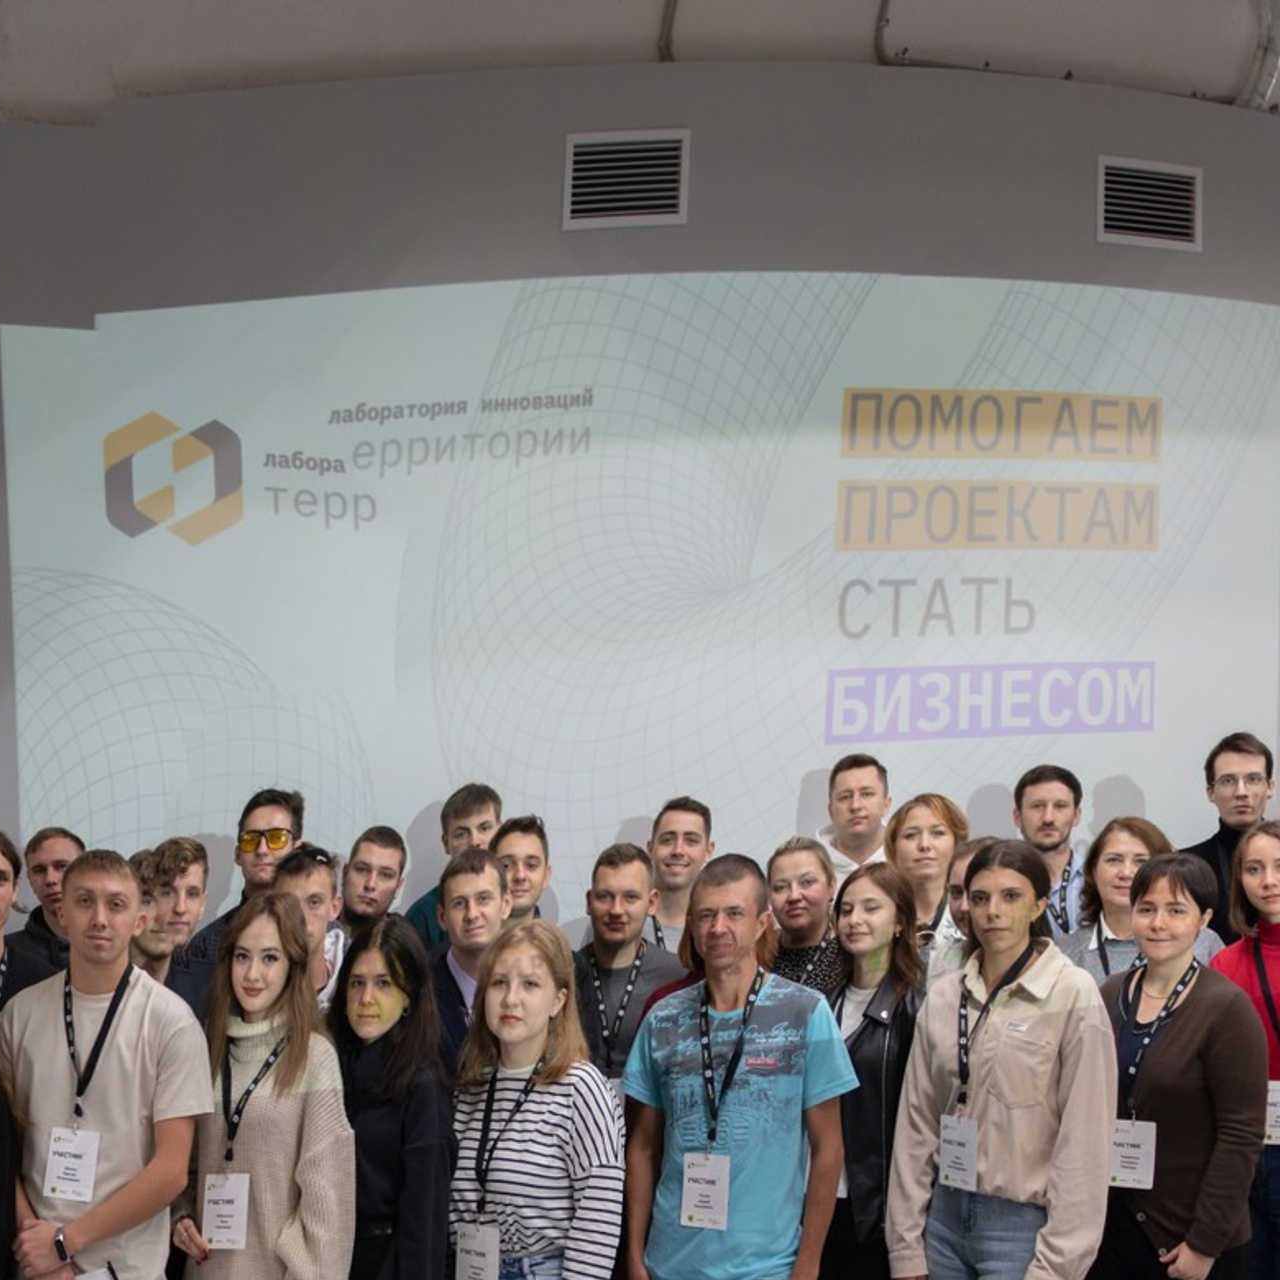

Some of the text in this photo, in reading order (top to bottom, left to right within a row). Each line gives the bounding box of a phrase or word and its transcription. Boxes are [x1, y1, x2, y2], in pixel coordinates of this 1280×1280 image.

[329, 389, 593, 425] лаборатория инноваций
[848, 395, 1158, 455] ПОМОГАЕМ
[263, 451, 345, 475] лабора
[353, 425, 591, 477] ерритории
[264, 485, 378, 530] терр
[842, 485, 1155, 543] ПРОЕКТАМ
[838, 578, 1035, 638] СТАТЬ
[832, 668, 1150, 735] БИЗНЕСОМ
